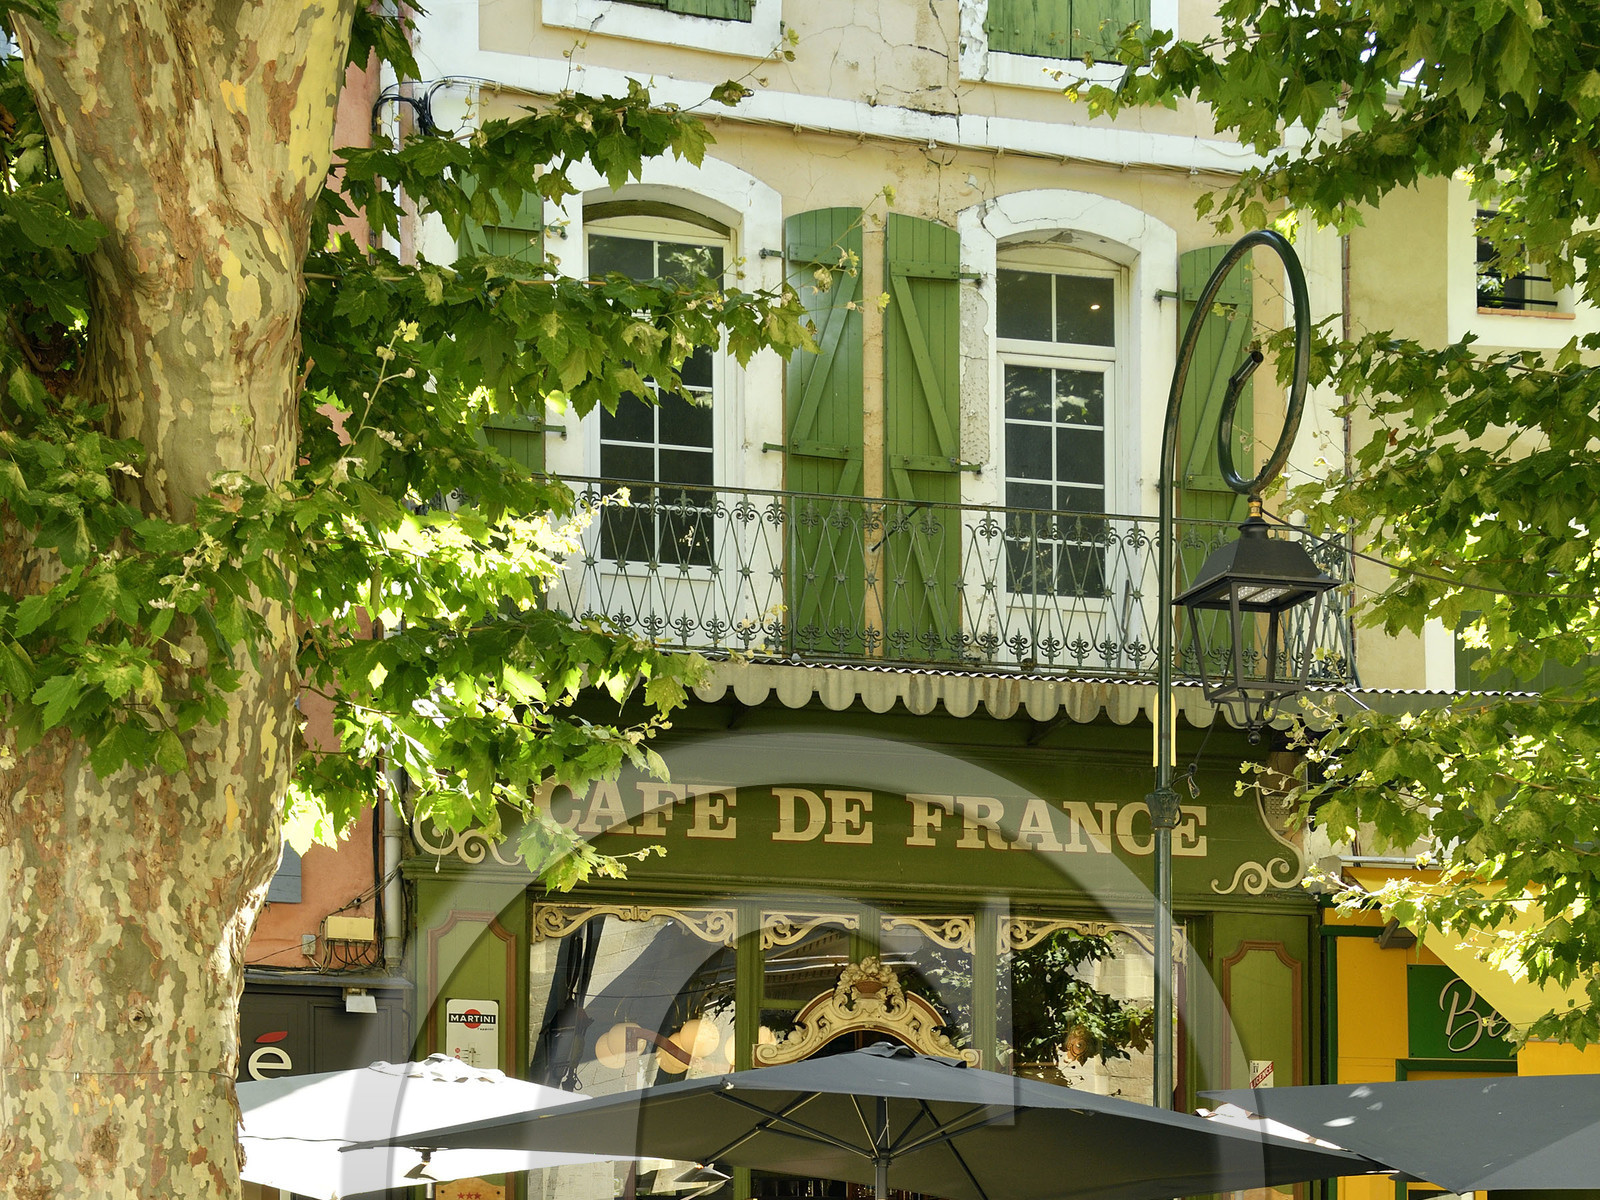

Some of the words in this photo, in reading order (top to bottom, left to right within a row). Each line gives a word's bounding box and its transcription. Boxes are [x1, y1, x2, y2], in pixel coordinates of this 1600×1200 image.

[771, 787, 873, 844] DE
[905, 793, 1208, 857] FRANCE
[450, 1014, 495, 1023] MARTINI
